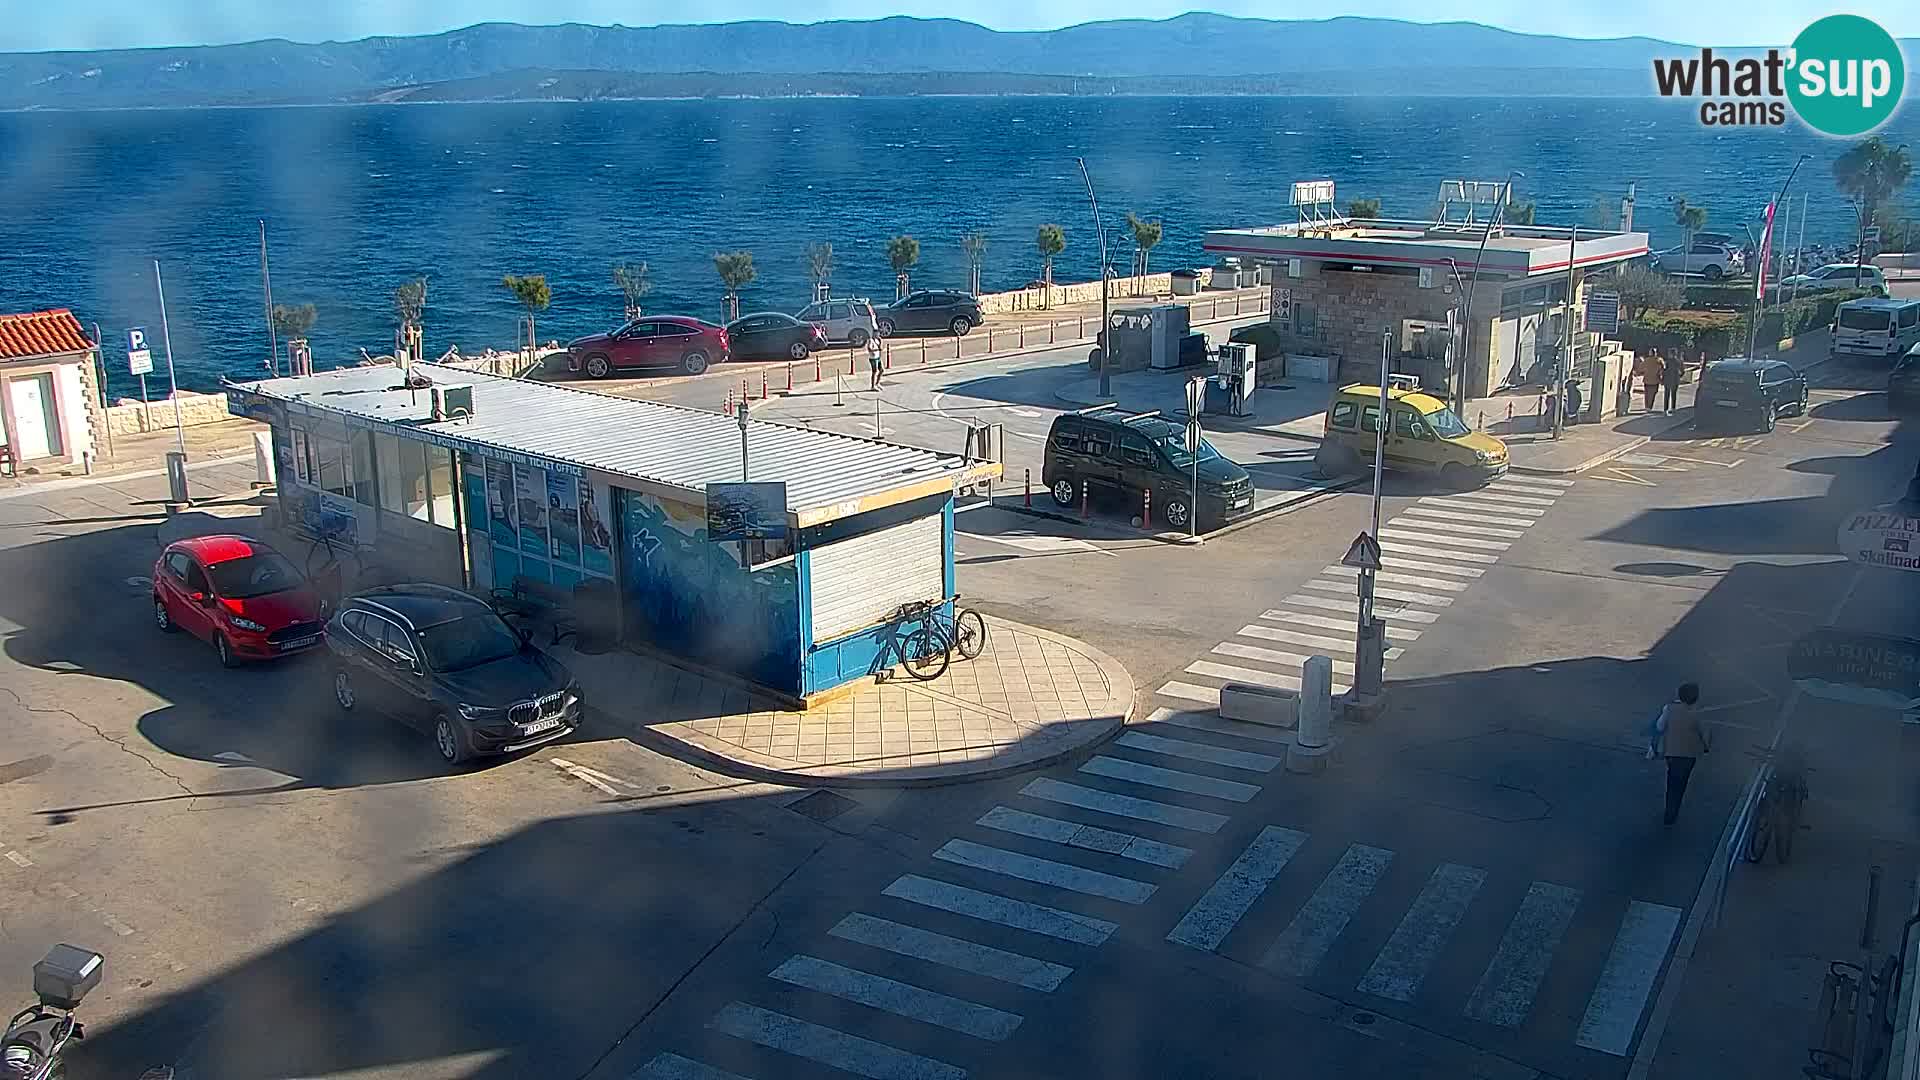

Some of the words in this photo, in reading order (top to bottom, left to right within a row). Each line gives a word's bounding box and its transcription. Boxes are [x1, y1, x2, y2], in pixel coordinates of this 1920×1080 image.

[130, 331, 144, 350] P
[479, 446, 493, 457] BUS
[495, 449, 527, 464] STATION
[529, 457, 555, 470] TICKET
[556, 463, 582, 476] OFFICE
